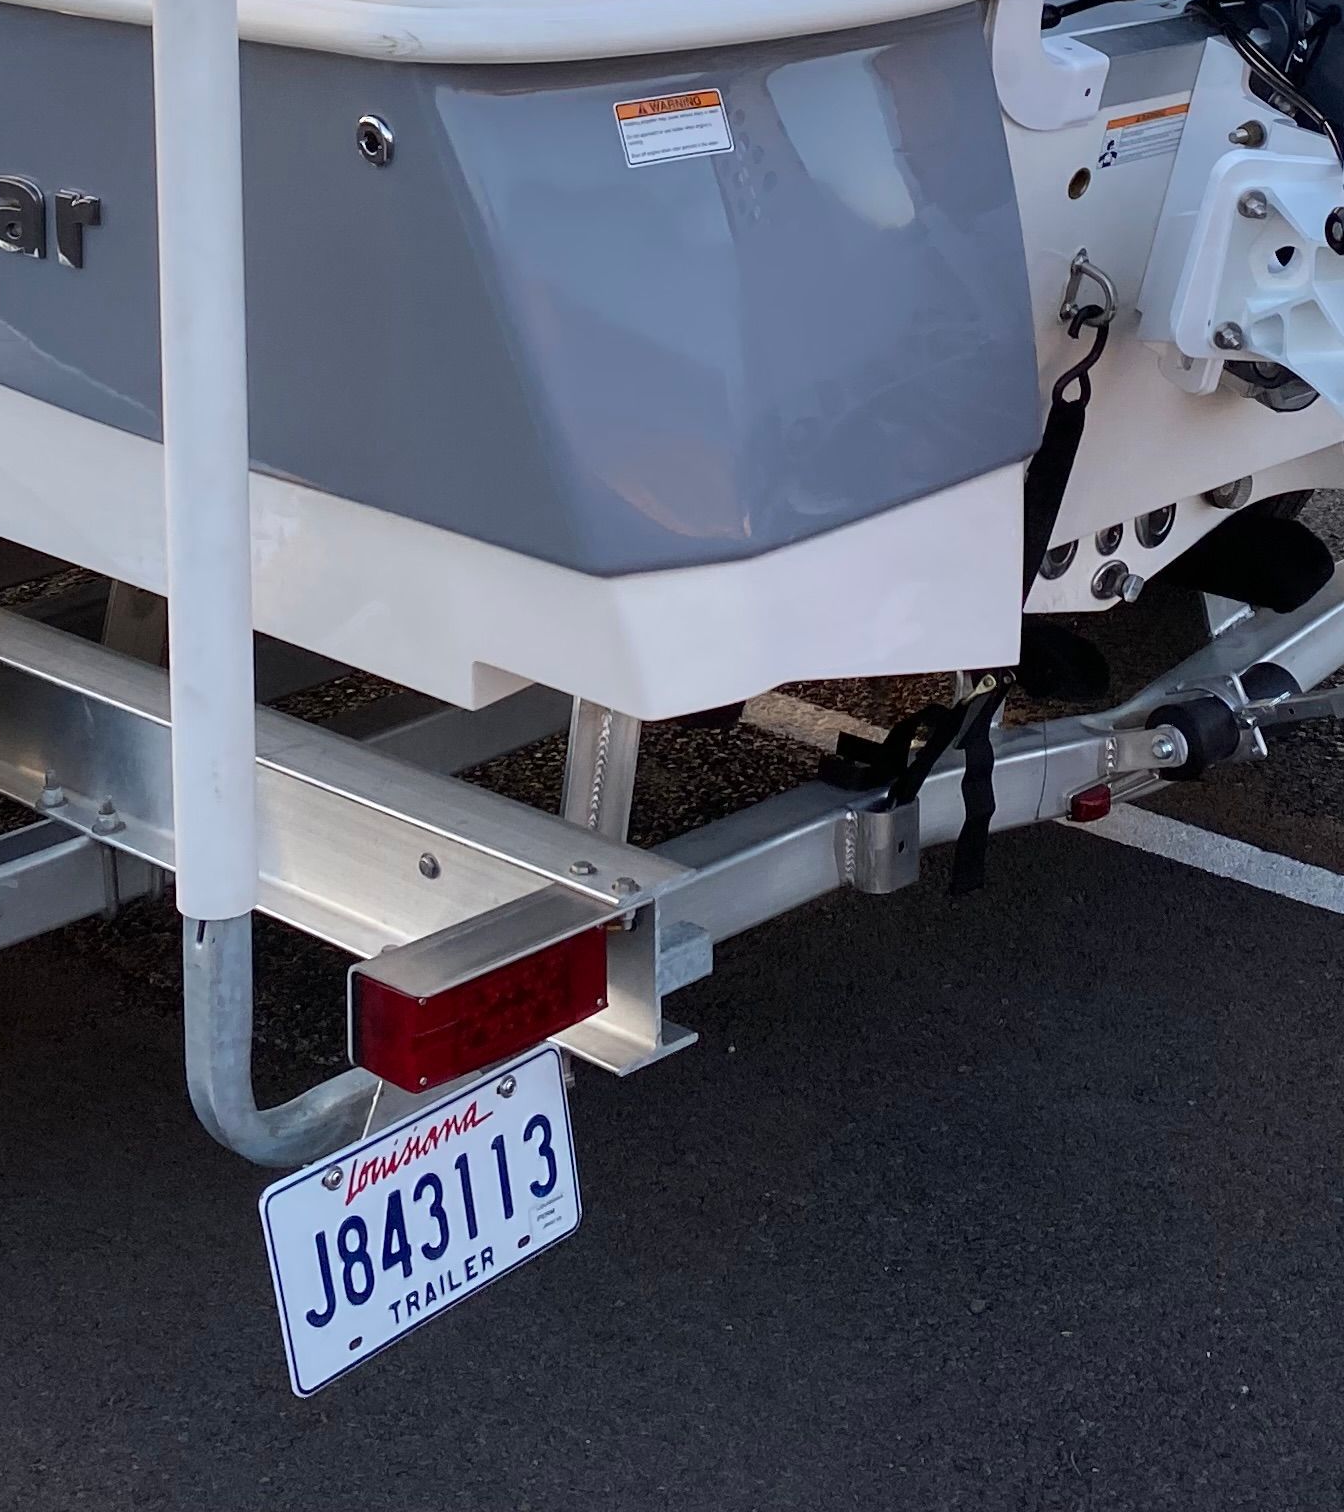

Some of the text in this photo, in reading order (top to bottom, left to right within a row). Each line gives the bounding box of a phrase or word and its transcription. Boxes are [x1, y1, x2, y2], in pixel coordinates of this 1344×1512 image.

[649, 96, 702, 113] WARNING
[346, 1101, 494, 1206] Louisiana
[306, 1113, 558, 1328] J843113
[388, 1245, 495, 1325] TRAILER
